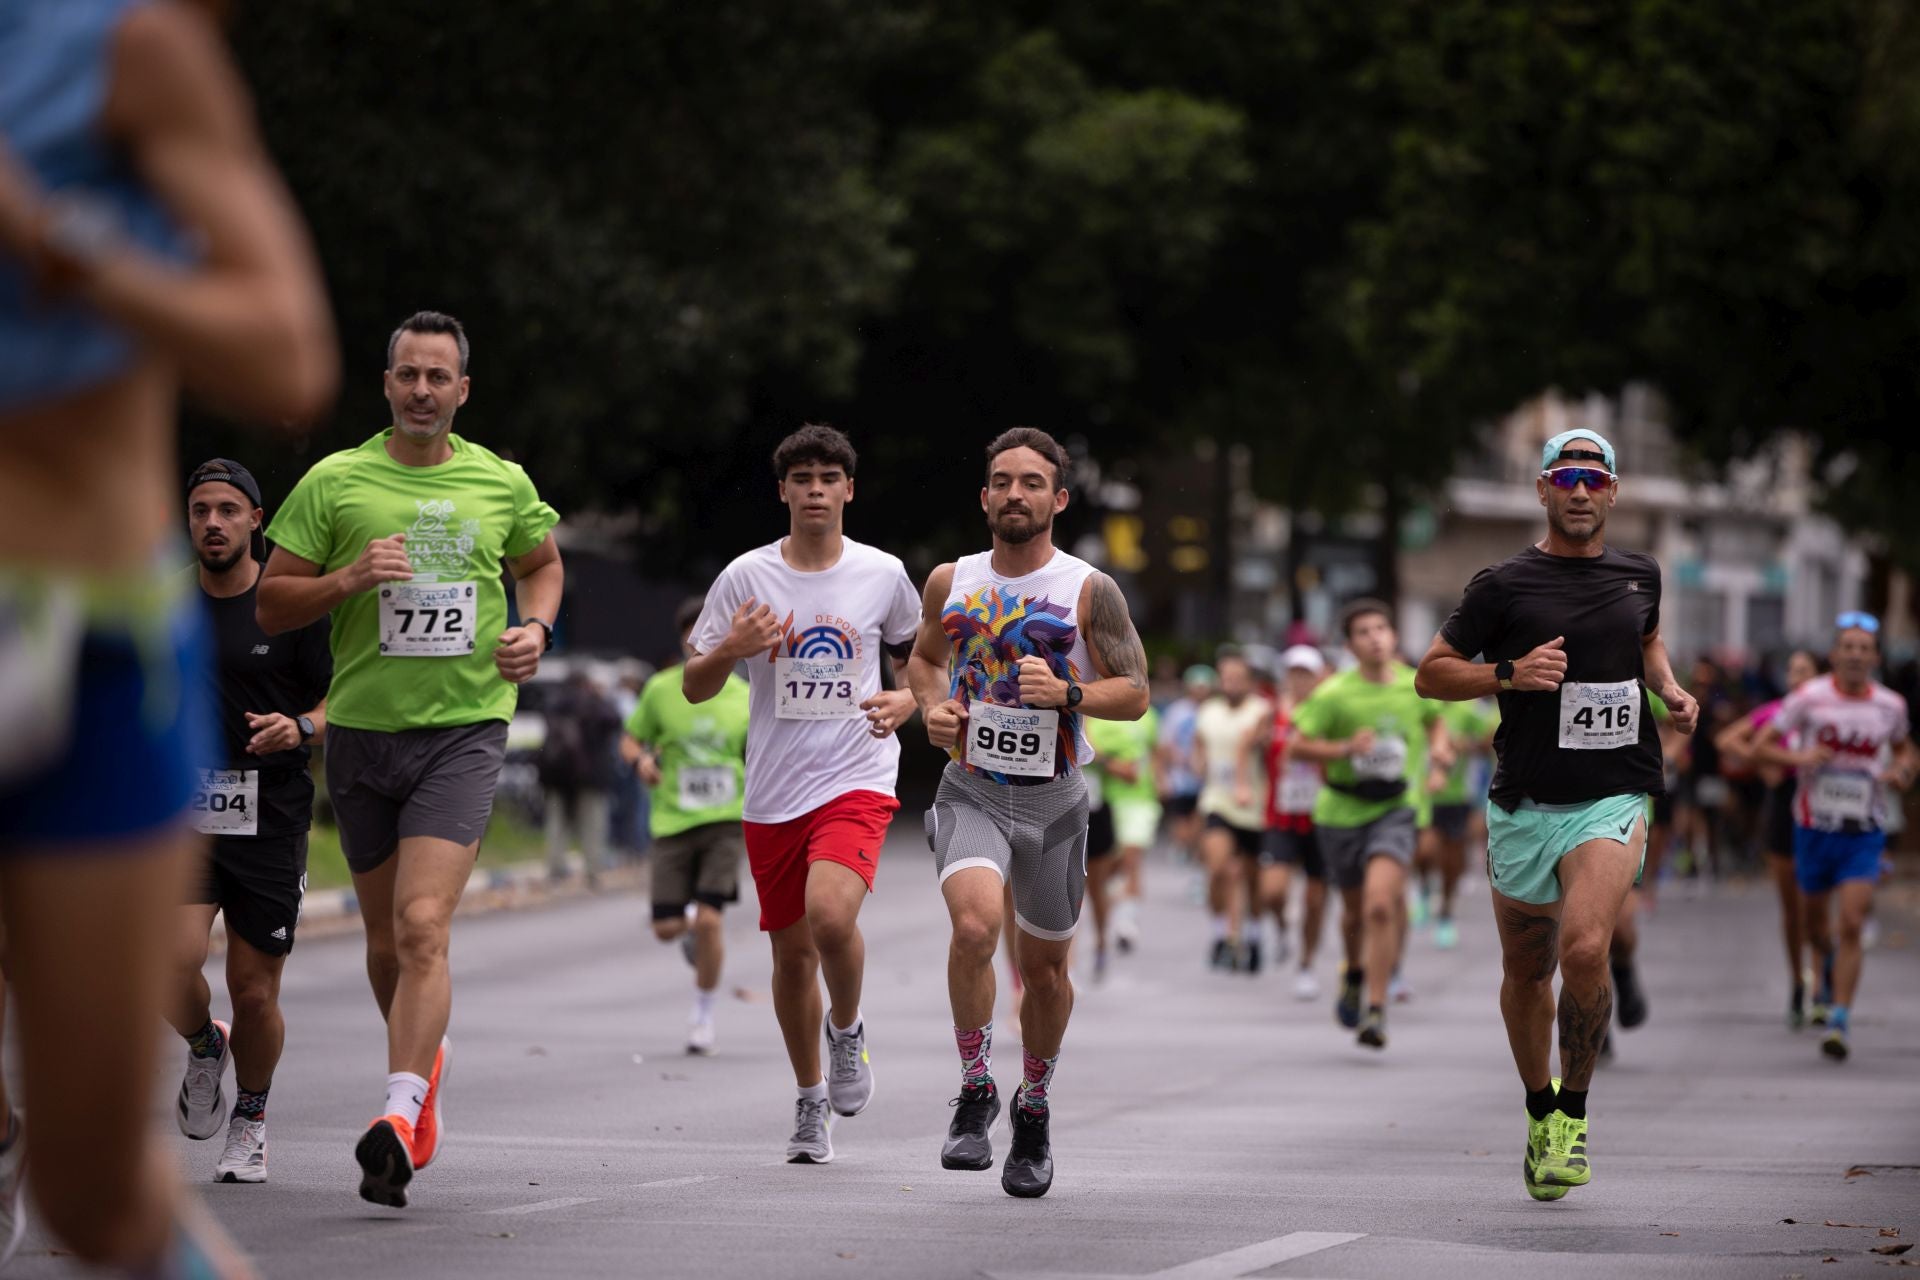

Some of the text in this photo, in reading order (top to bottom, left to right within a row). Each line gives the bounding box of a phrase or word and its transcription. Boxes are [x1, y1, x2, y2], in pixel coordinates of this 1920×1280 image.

[394, 608, 462, 634] 772
[785, 681, 851, 699] 1773
[1573, 705, 1631, 729] 416
[977, 727, 1040, 755] 969
